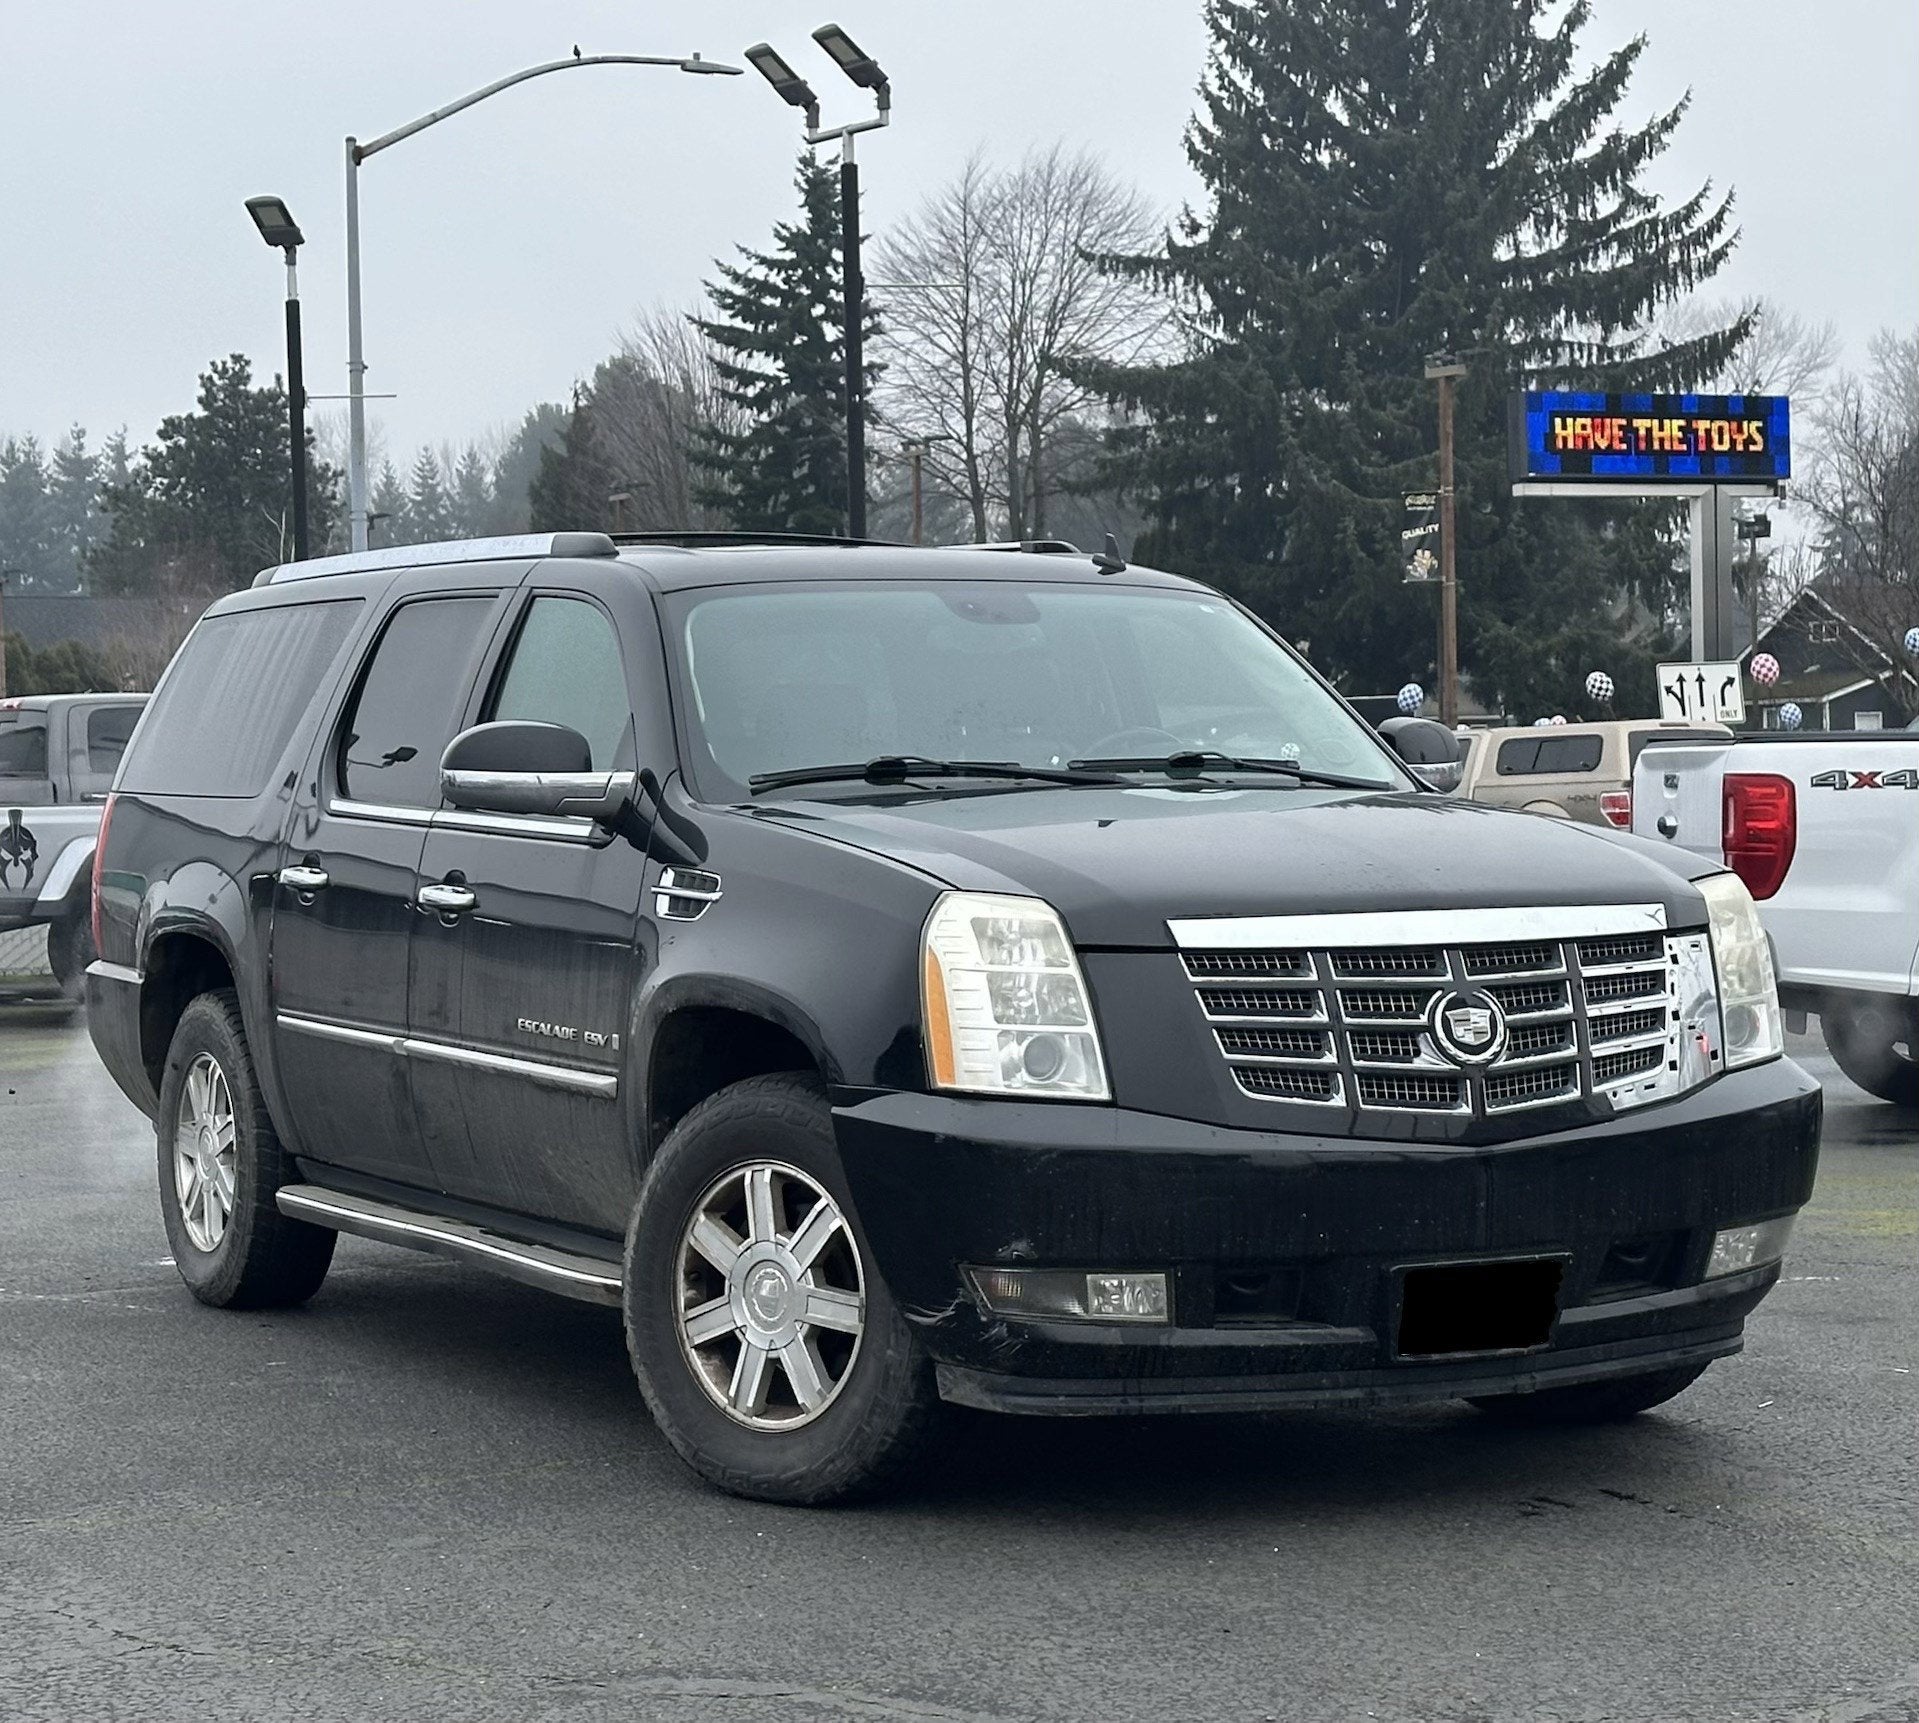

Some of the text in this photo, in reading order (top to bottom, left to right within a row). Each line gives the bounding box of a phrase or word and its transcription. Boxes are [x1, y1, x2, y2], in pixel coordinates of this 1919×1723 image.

[1554, 417, 1763, 452] HAVE THE TOYS
[1402, 523, 1440, 539] QUALITY
[1720, 709, 1738, 719] ONLY
[517, 1018, 609, 1047] ESCALADE ESV
